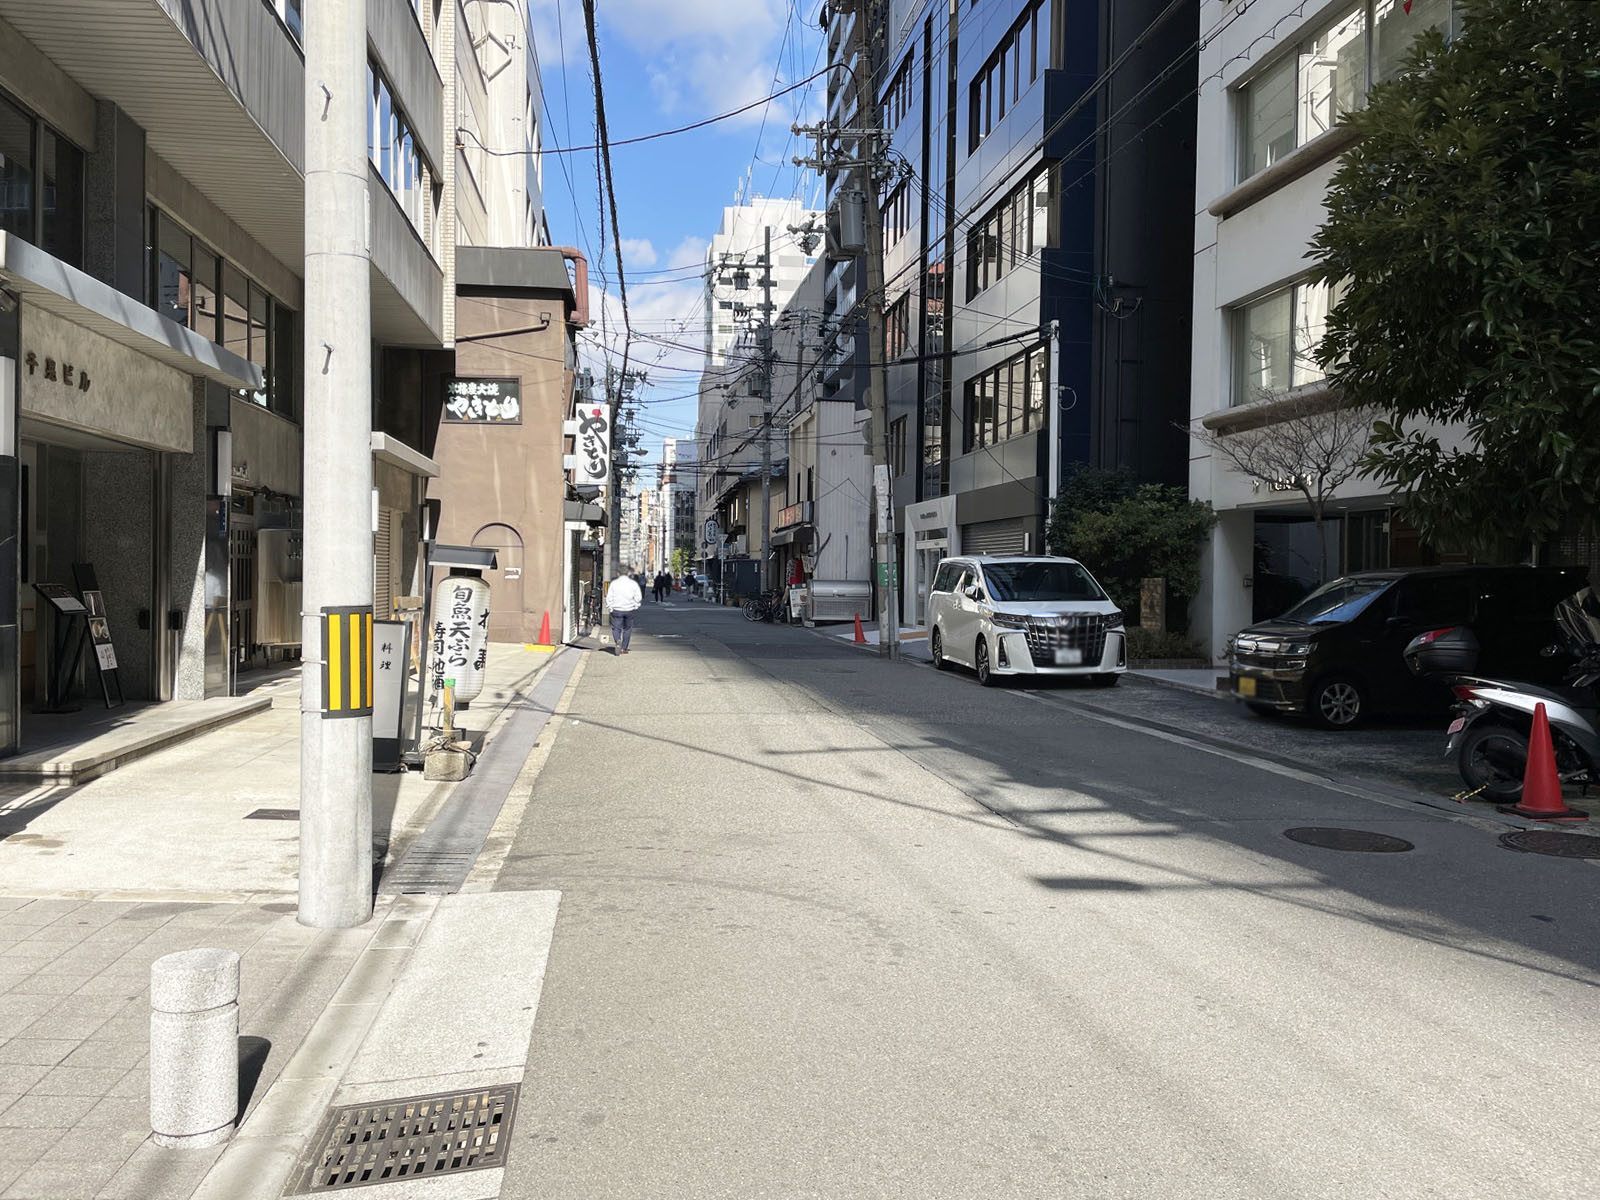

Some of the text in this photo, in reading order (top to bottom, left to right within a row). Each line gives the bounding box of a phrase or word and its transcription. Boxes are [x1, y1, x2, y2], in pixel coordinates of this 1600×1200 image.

[578, 409, 608, 479] やきとり
[379, 643, 393, 670] 料理
